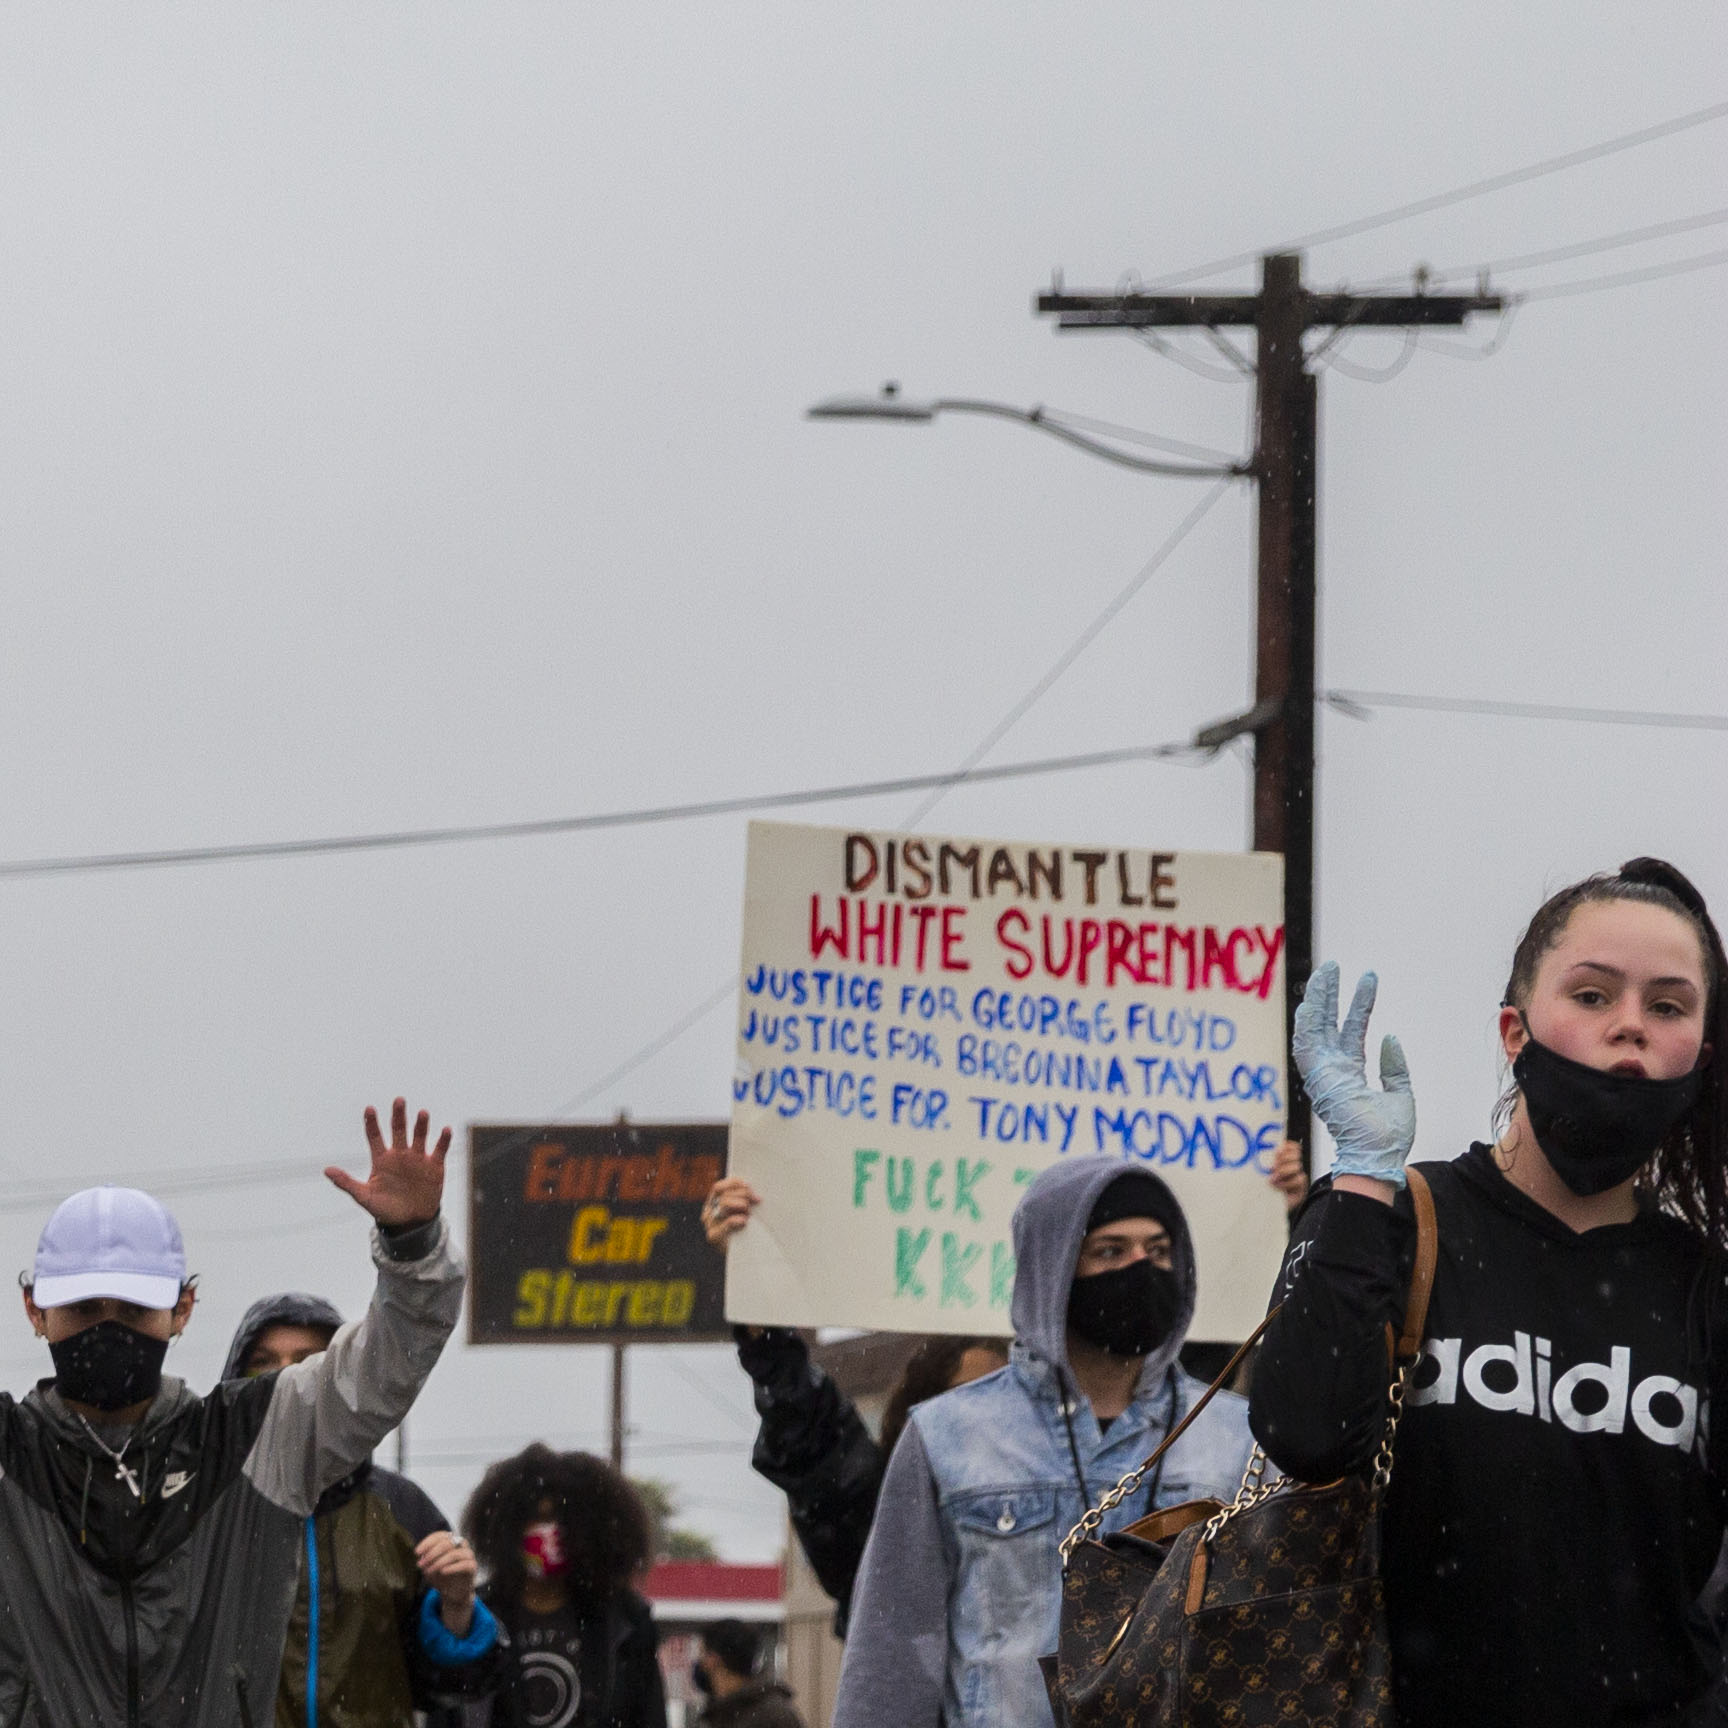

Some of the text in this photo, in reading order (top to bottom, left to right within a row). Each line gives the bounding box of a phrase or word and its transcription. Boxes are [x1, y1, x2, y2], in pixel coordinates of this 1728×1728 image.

[845, 833, 1177, 909] DISMANTLE
[809, 894, 1286, 1000] WHITE SUPREMACY
[746, 964, 1237, 1052] JUSTICE FOR GEORGE FLOYD
[742, 1010, 1284, 1110] JUSTICE FOR BREONNA TAYLOR
[968, 1096, 1078, 1153] TONY
[1095, 1112, 1281, 1175] MCDADE
[851, 1149, 995, 1222] FUCK
[567, 1204, 670, 1265] Car
[512, 1267, 696, 1327] Stereo
